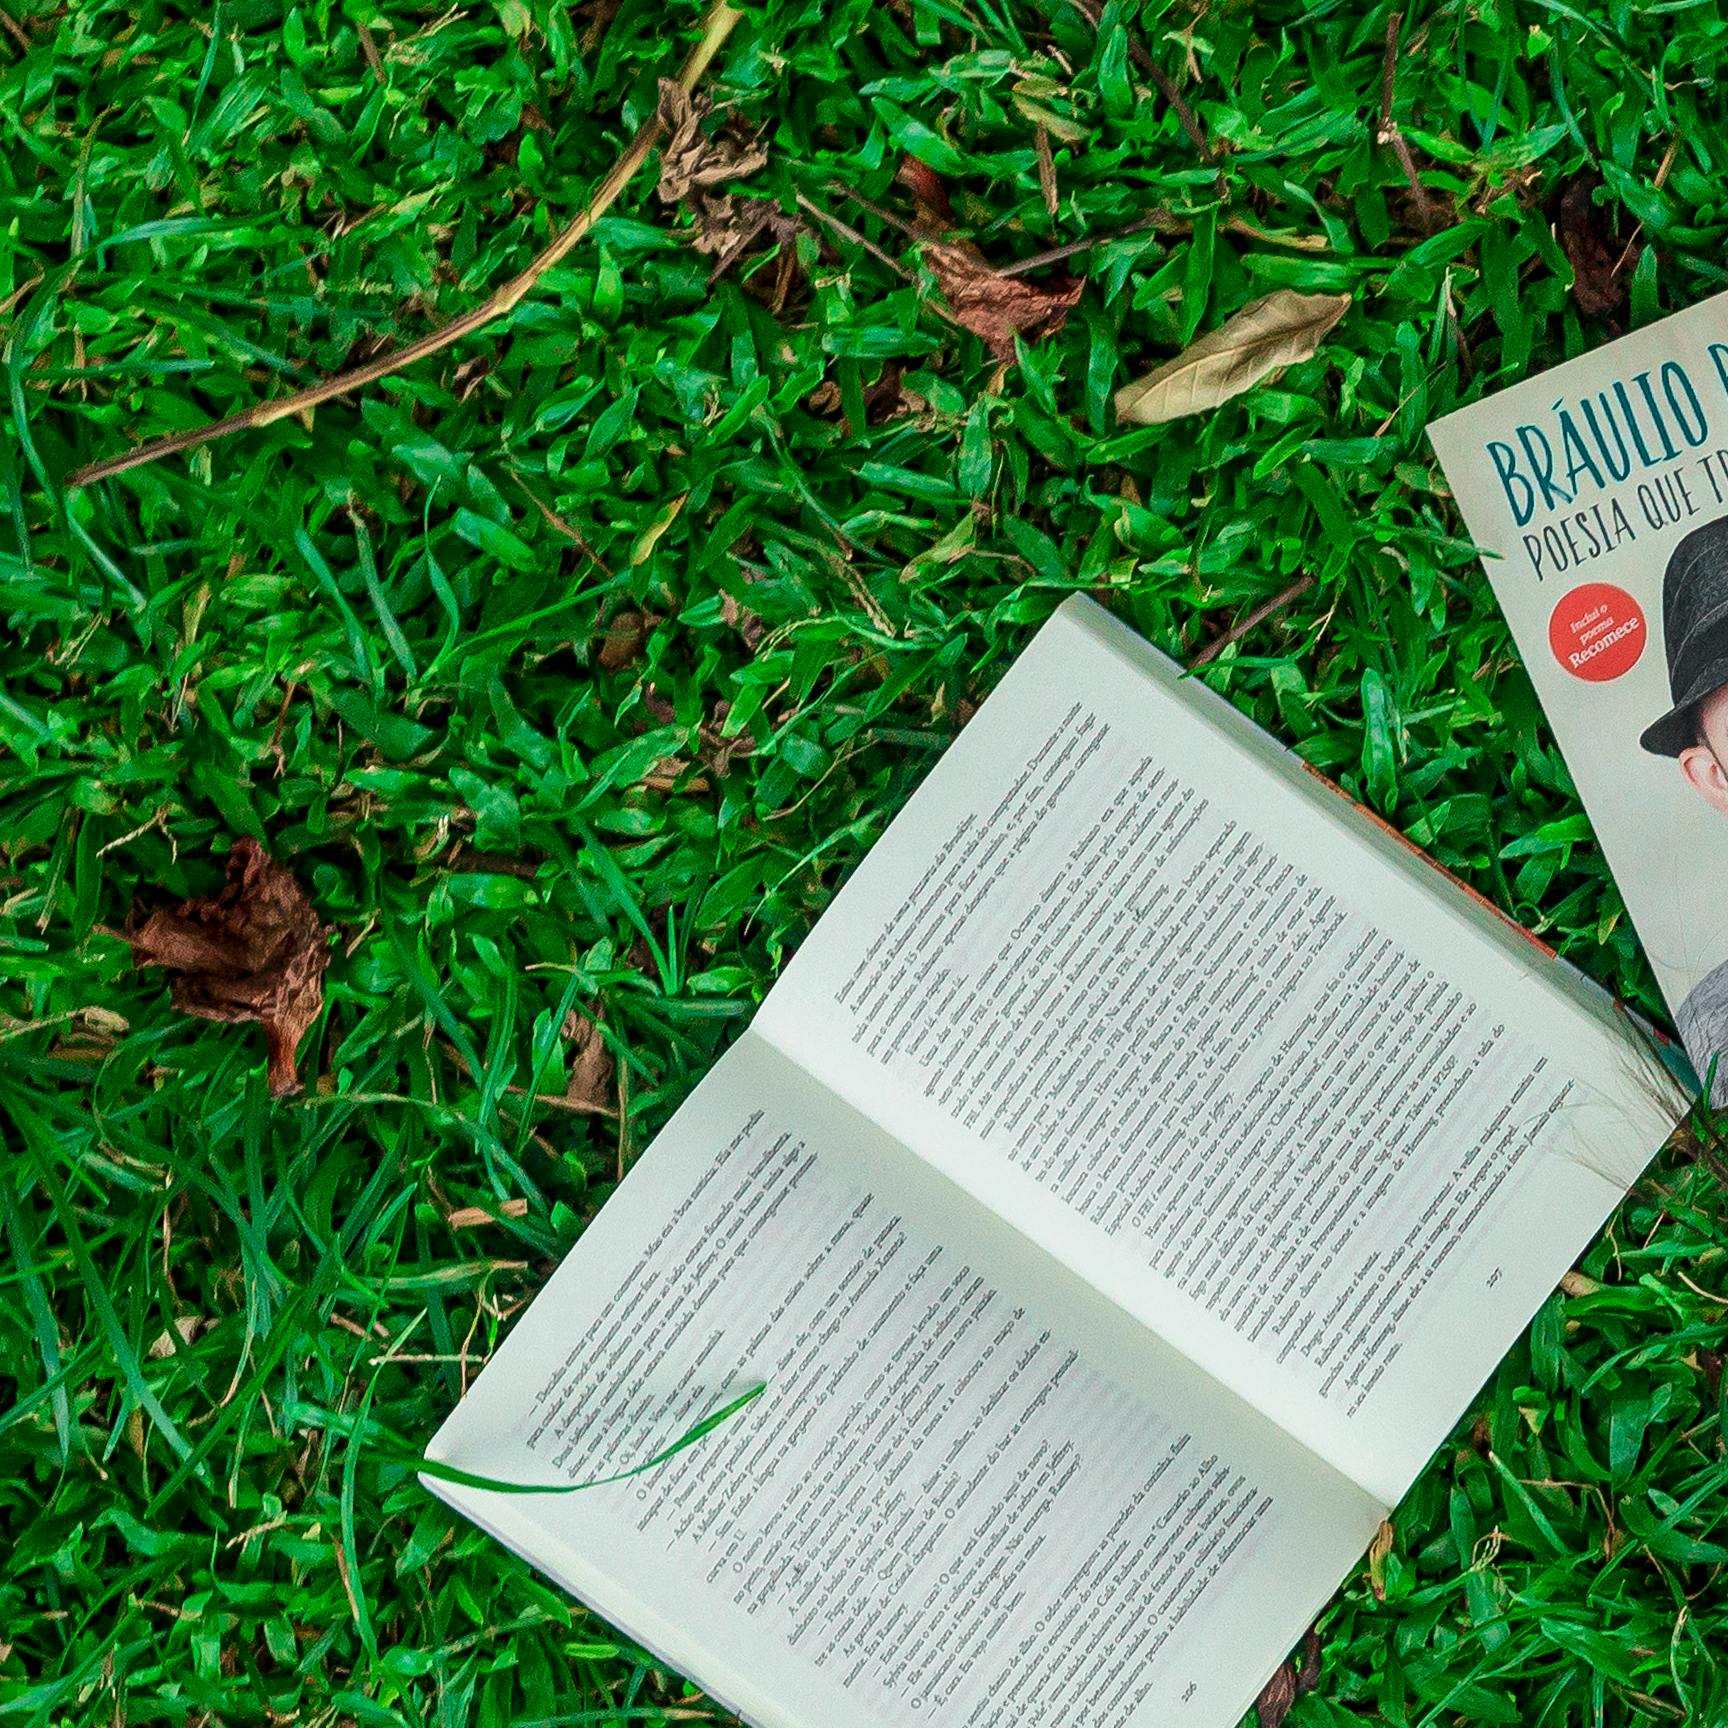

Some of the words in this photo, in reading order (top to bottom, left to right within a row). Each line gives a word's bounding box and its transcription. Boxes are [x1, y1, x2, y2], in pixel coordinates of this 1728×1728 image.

[1486, 359, 1709, 527] BRÁULIO
[1521, 496, 1637, 582] POESIA
[1640, 465, 1702, 527] QUE
[1569, 607, 1601, 633] Inclui
[1600, 604, 1608, 613] o
[1579, 616, 1615, 646] poema
[1568, 617, 1640, 669] Recomece
[1131, 1215, 1142, 1229] O
[1155, 1172, 1174, 1196] mais
[1188, 1135, 1201, 1150] do
[1198, 1118, 1214, 1140] que
[1485, 1266, 1503, 1289] 207
[1180, 1680, 1198, 1704] 206
[1122, 1702, 1137, 1718] de
